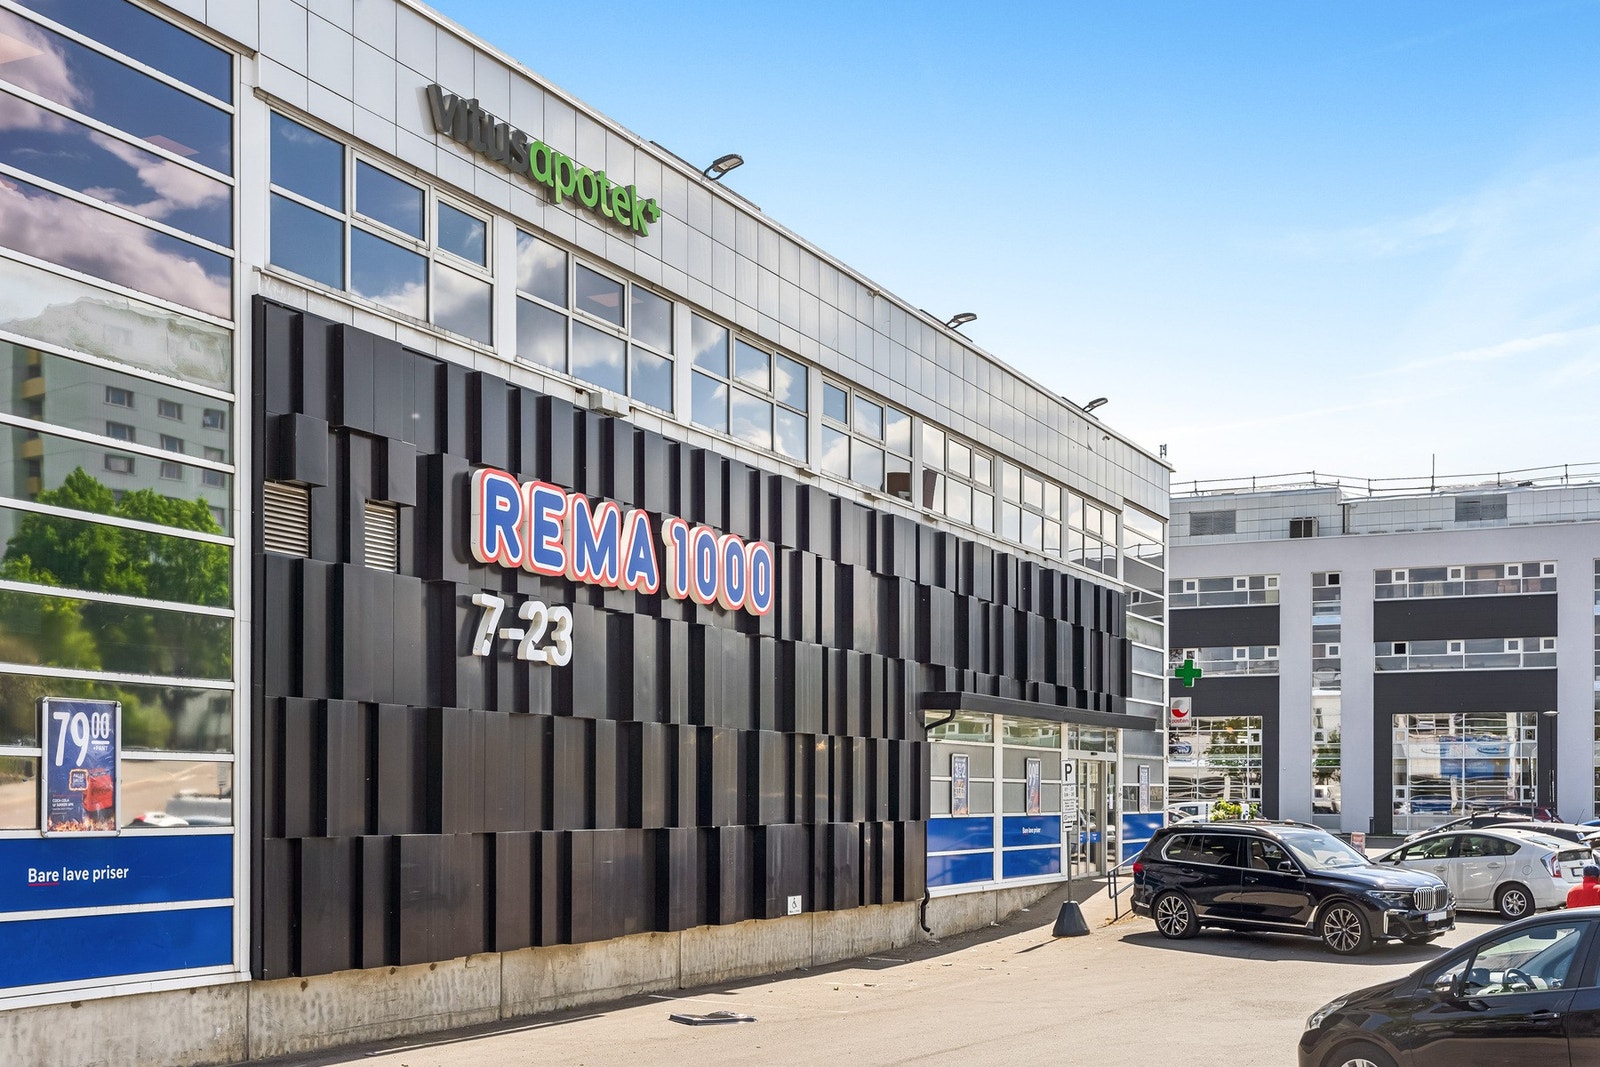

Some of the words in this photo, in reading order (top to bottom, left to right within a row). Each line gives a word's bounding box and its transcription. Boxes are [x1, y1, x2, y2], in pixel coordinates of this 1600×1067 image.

[471, 467, 660, 595] REMA
[662, 517, 775, 616] 1000
[472, 593, 573, 667] 7-23
[1065, 763, 1073, 781] P
[28, 868, 59, 883] Bare
[63, 867, 89, 881] lave
[92, 865, 129, 883] priser
